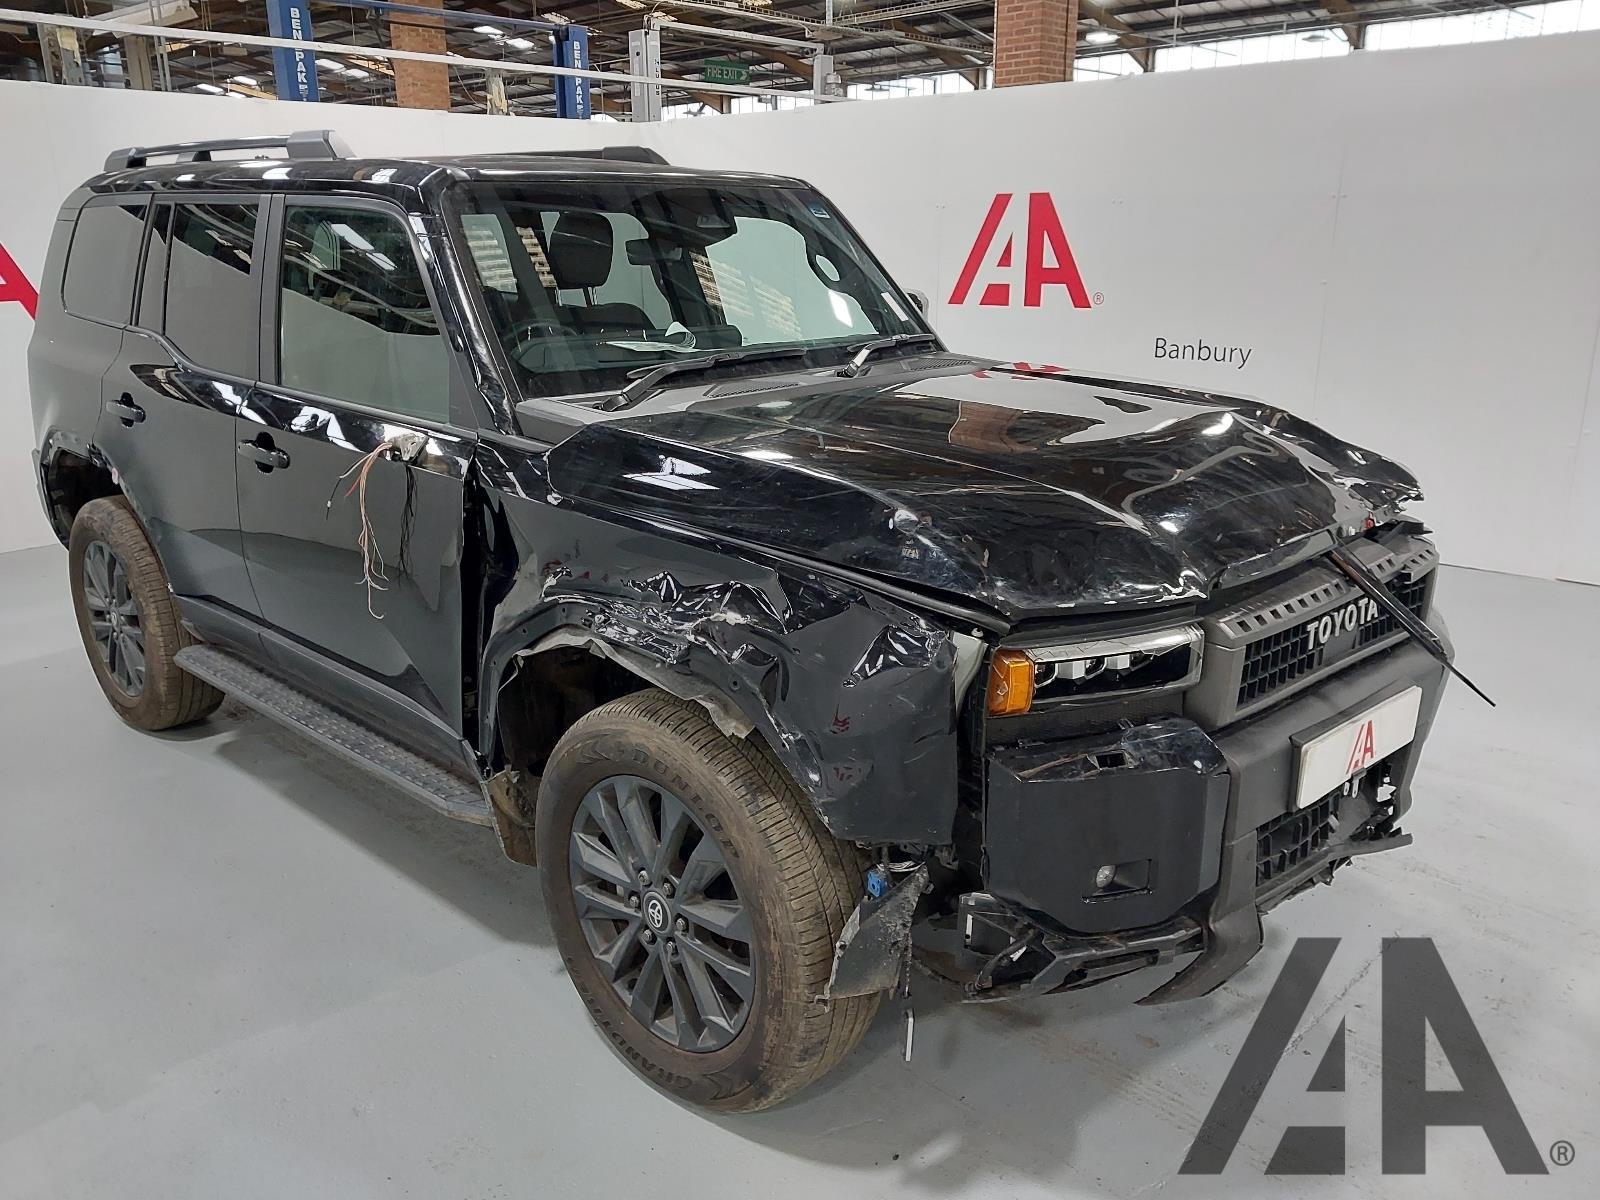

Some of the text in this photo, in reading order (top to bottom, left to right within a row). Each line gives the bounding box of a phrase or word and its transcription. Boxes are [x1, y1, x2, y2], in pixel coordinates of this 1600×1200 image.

[290, 7, 307, 83] BENPAK
[573, 41, 584, 104] BENPAK
[707, 67, 737, 80] FIRE EXIT
[1154, 337, 1252, 370] Banbury
[1307, 597, 1379, 650] TOYOTA
[633, 748, 740, 858] DUNLOP
